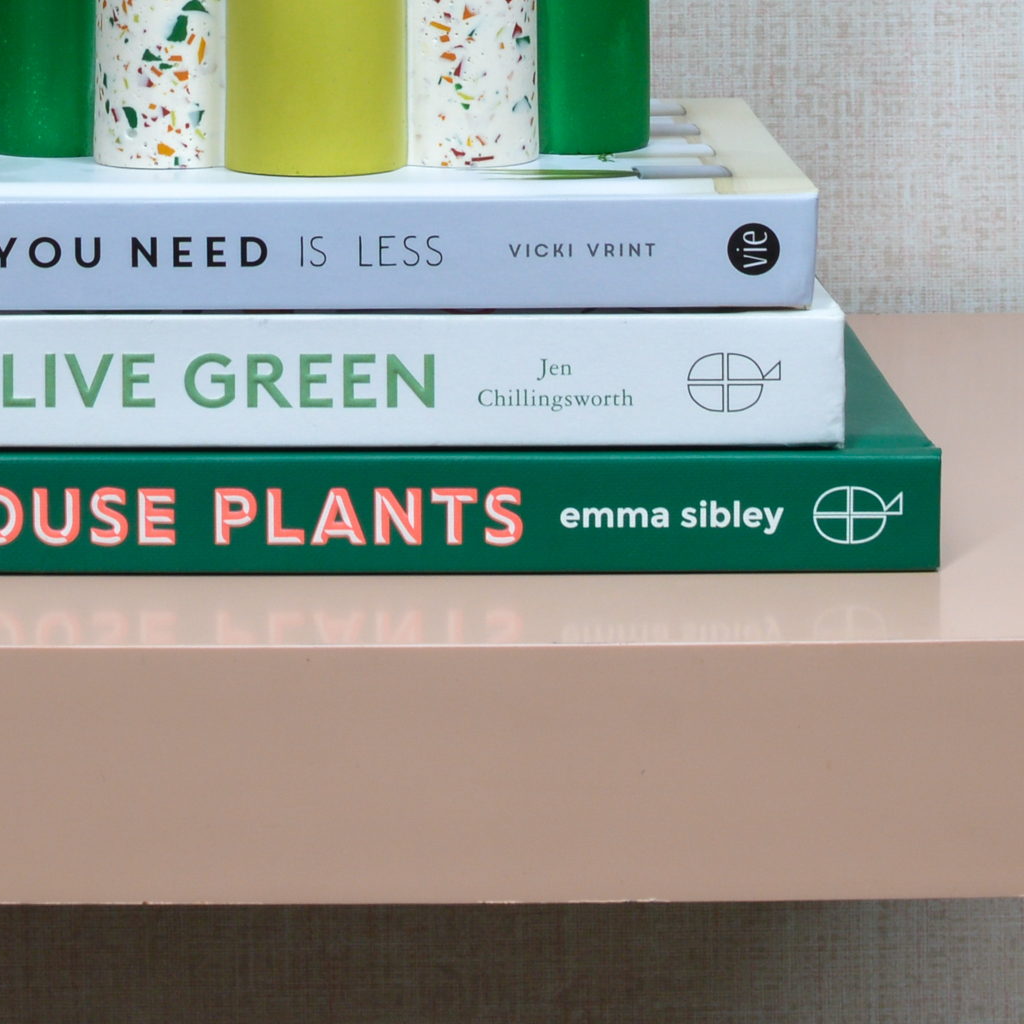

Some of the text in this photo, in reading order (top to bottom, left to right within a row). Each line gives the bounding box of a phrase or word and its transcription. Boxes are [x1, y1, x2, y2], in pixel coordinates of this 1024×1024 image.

[130, 235, 269, 268] NEED
[299, 235, 328, 268] IS
[357, 234, 445, 268] LESS
[508, 242, 657, 259] VICKI VRINT
[735, 229, 769, 269] vie
[1, 352, 437, 409] LIVE GREEN
[536, 357, 573, 382] Jen
[476, 387, 635, 413] Chillingsworth
[212, 485, 526, 548] PLANTS
[558, 499, 786, 537] emma sibley
